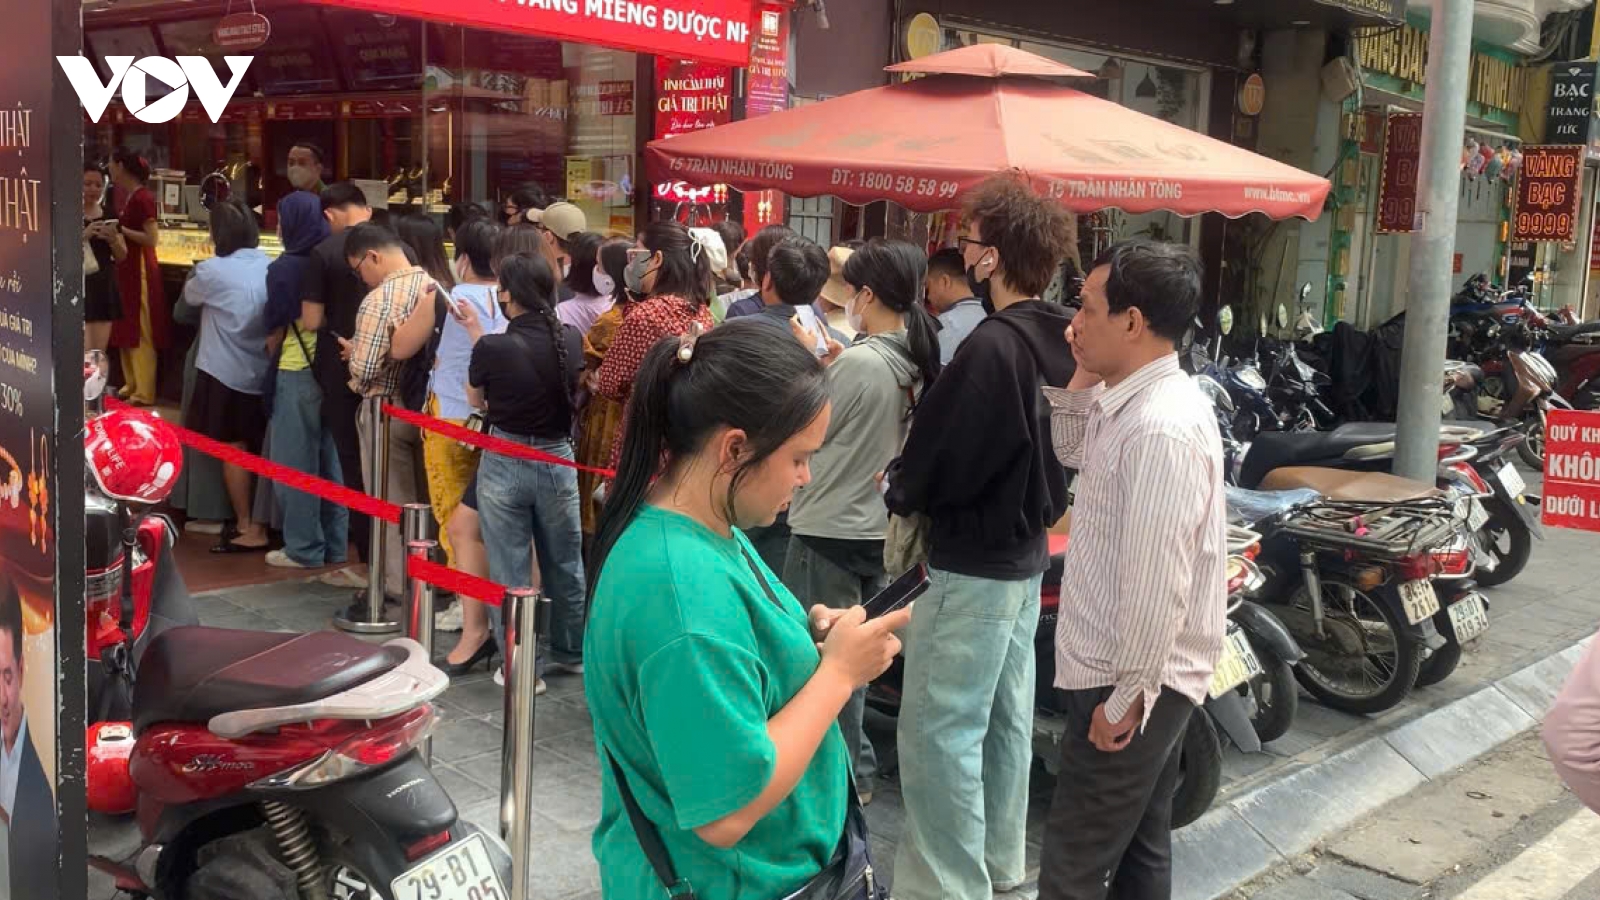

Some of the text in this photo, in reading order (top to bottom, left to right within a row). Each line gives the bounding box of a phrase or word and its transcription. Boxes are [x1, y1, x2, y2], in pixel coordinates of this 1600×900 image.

[662, 8, 721, 41] ĐƯỢC
[702, 93, 728, 113] THẬT
[1554, 83, 1590, 101] BẠC
[1550, 107, 1590, 116] TRANG
[1525, 151, 1576, 178] VÀNG
[859, 171, 893, 191] 1800
[895, 174, 915, 193] 58
[917, 178, 937, 196] 58
[938, 180, 959, 198] 99
[1527, 181, 1567, 210] BẠC
[1518, 211, 1571, 236] 9999
[1, 382, 23, 417] 30%
[1550, 423, 1579, 442] QUÝ
[1546, 494, 1585, 517] DƯỚI
[385, 778, 426, 798] HONDA
[408, 846, 479, 900] 29-B1
